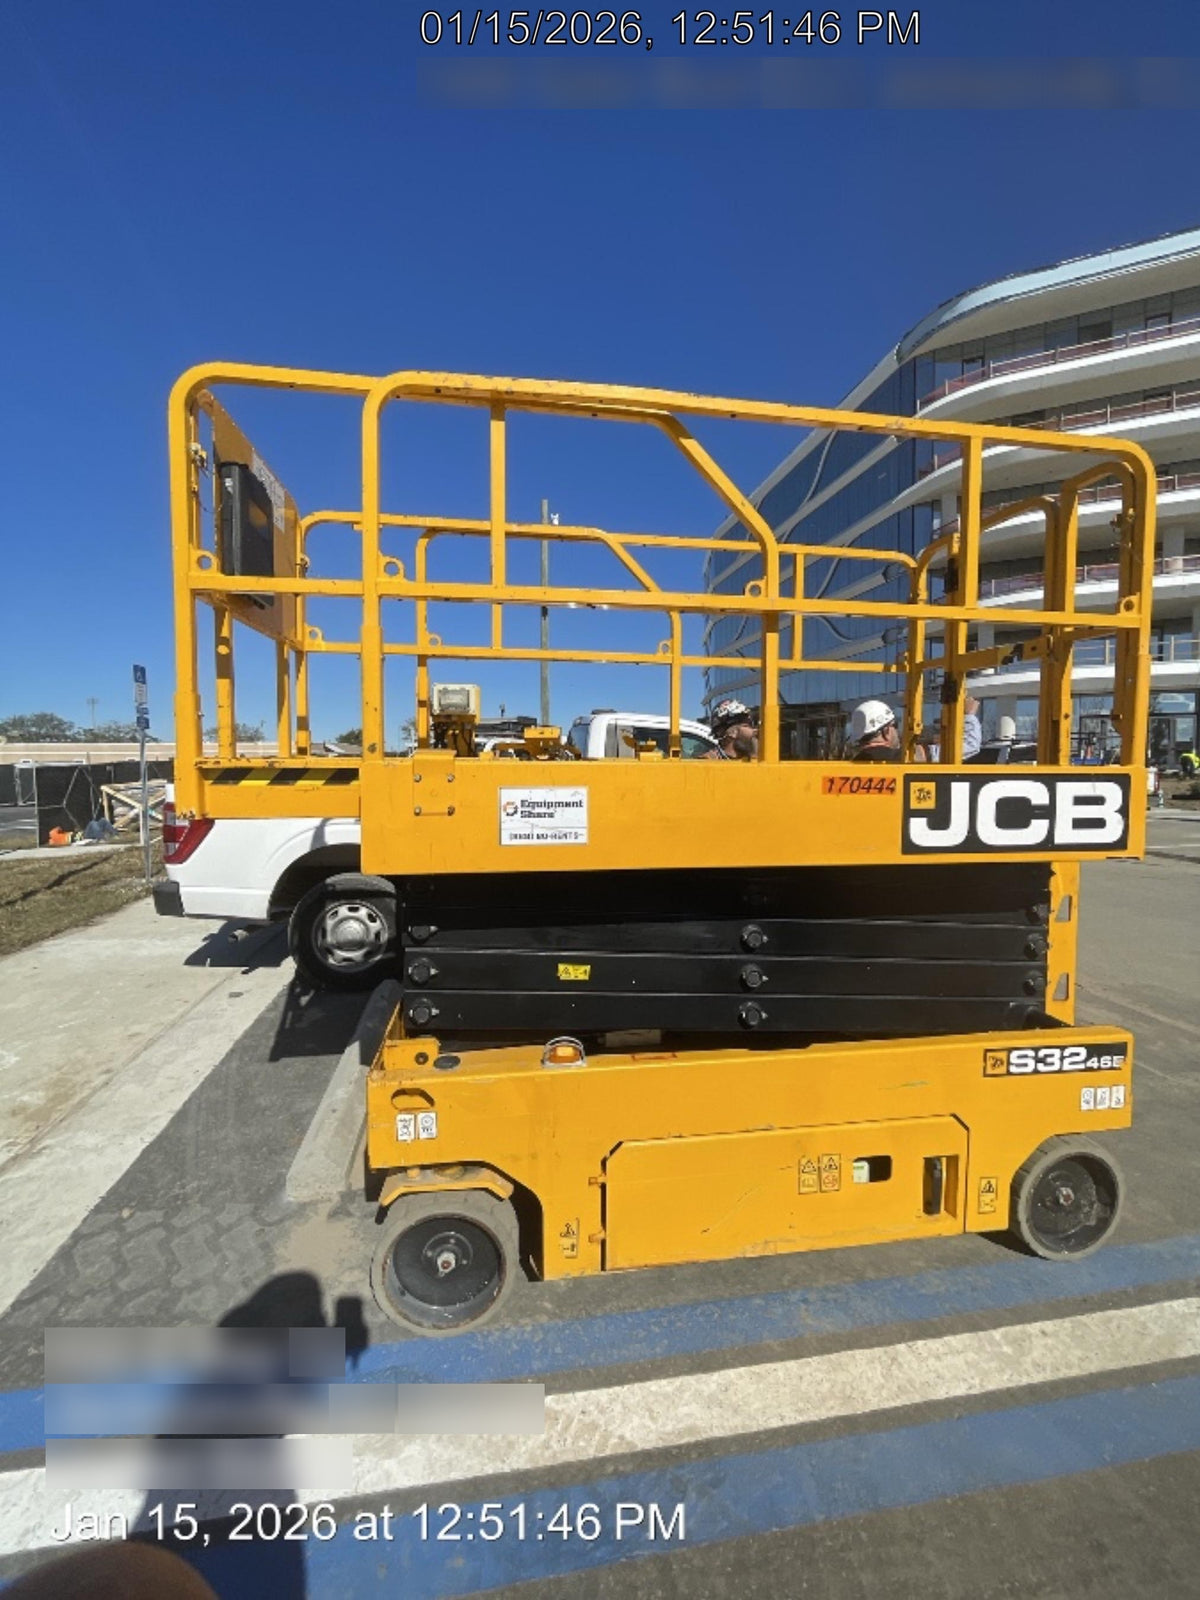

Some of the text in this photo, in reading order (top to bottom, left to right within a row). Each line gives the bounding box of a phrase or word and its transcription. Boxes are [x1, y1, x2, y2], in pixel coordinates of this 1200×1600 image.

[827, 776, 897, 794] 170444
[520, 799, 583, 810] Equipment
[520, 810, 555, 819] Share
[909, 780, 1124, 847] JCB
